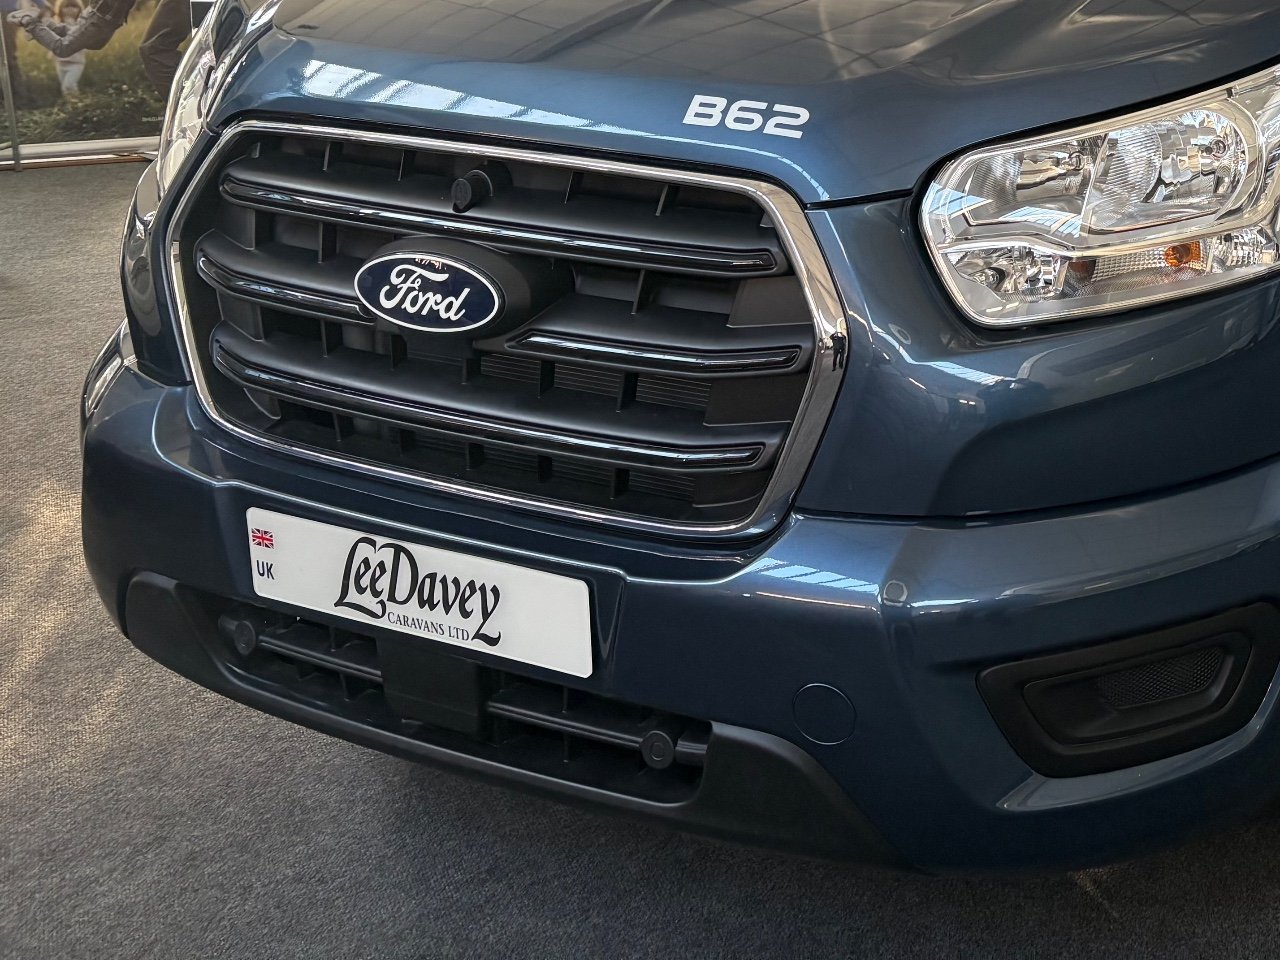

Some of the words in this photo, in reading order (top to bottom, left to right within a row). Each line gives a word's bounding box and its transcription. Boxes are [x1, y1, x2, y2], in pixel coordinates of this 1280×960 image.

[682, 94, 811, 139] B62
[379, 264, 471, 321] Ford
[256, 560, 275, 580] UK
[387, 611, 445, 636] CARAVANS
[448, 625, 470, 642] LTD
